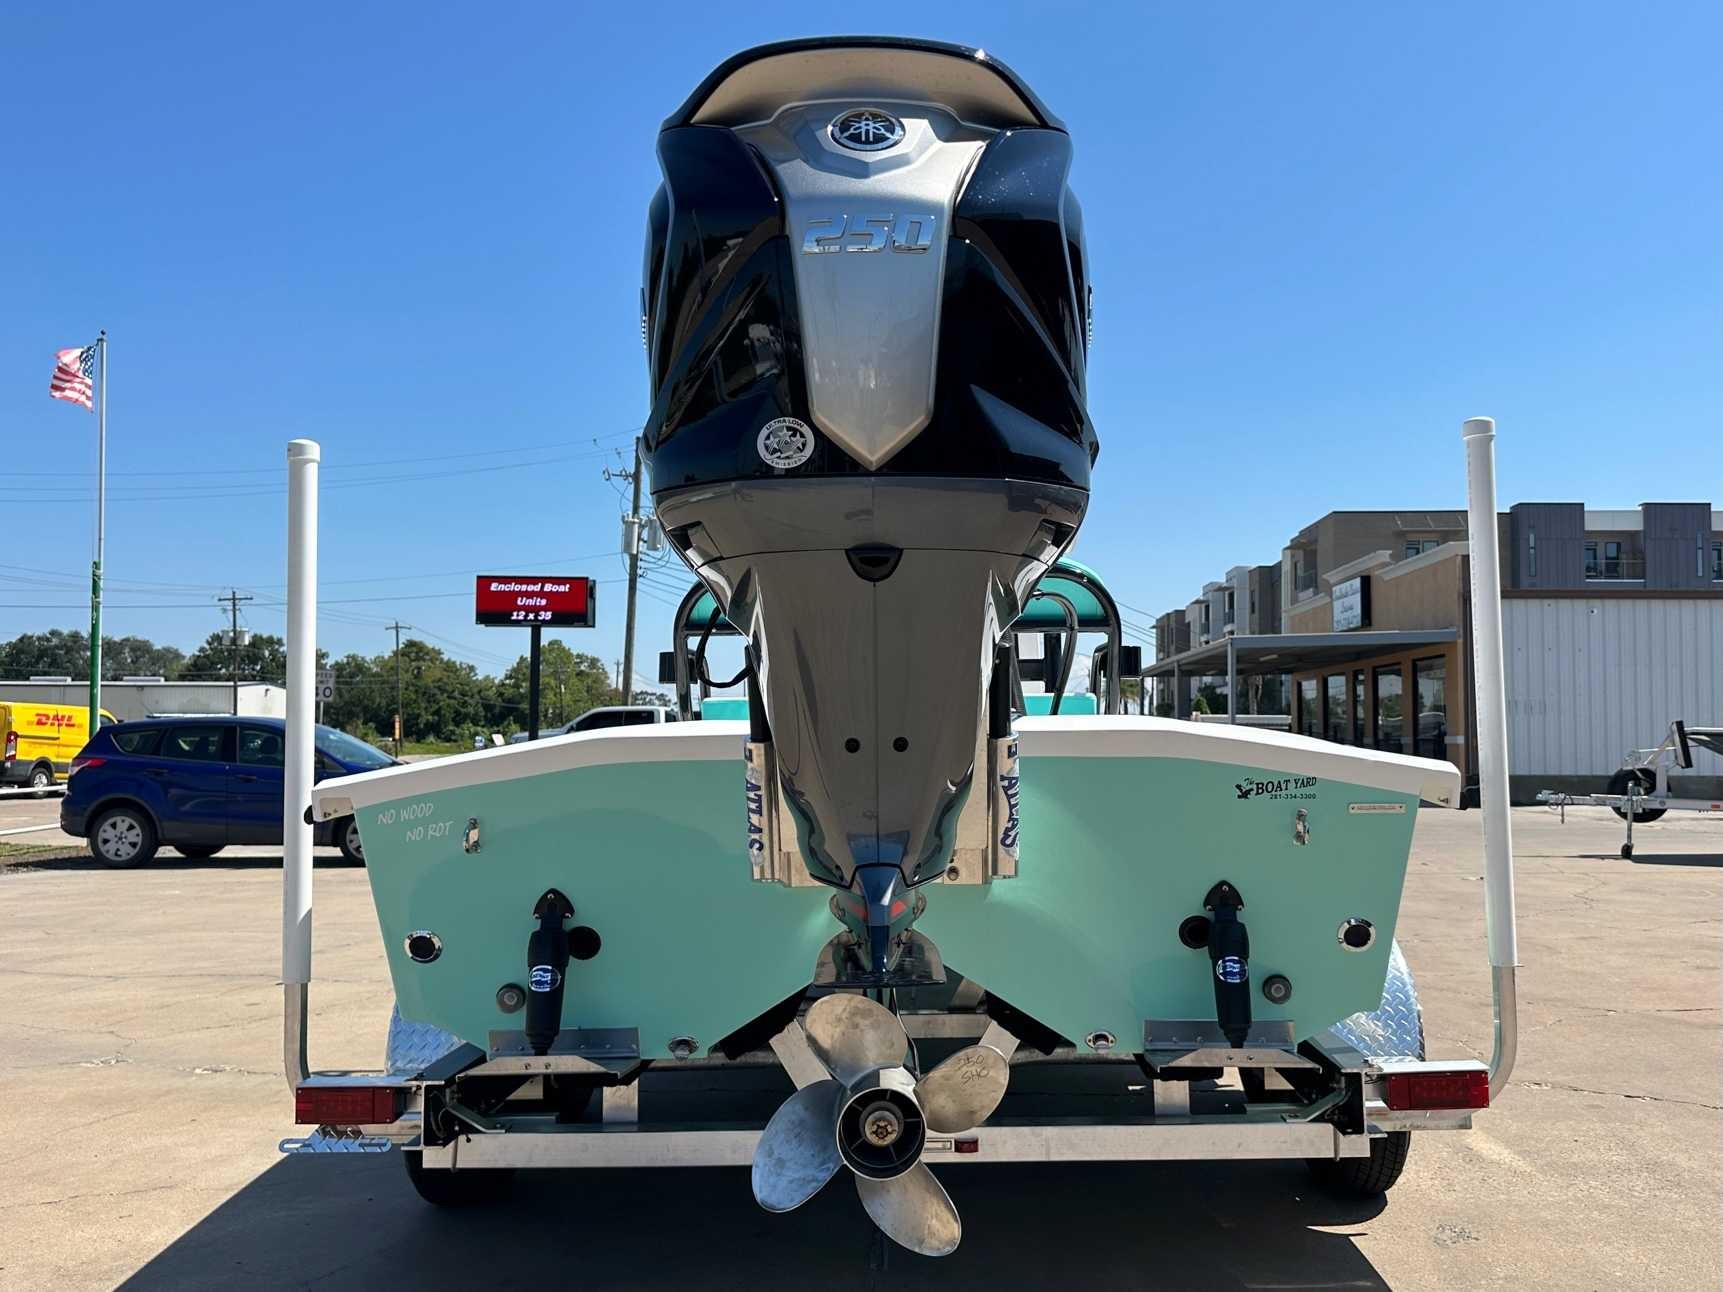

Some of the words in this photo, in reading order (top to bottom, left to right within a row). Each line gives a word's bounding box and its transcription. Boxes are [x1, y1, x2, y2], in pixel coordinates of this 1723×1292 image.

[799, 213, 936, 255] 250
[765, 418, 787, 431] ULTRA
[788, 418, 805, 429] LOW
[490, 582, 541, 592] Enclosed
[543, 583, 571, 592] Boat
[516, 597, 547, 606] Units
[510, 611, 525, 620] 12
[527, 612, 535, 620] x
[537, 611, 553, 620] 35
[35, 712, 76, 728] DHL
[1255, 779, 1291, 796] BOAT
[1294, 776, 1317, 790] YARD
[377, 809, 396, 825] NO
[400, 802, 434, 822] WOOD
[1000, 774, 1019, 849] ATLAS
[405, 826, 424, 843] NO
[427, 820, 455, 841] ROT
